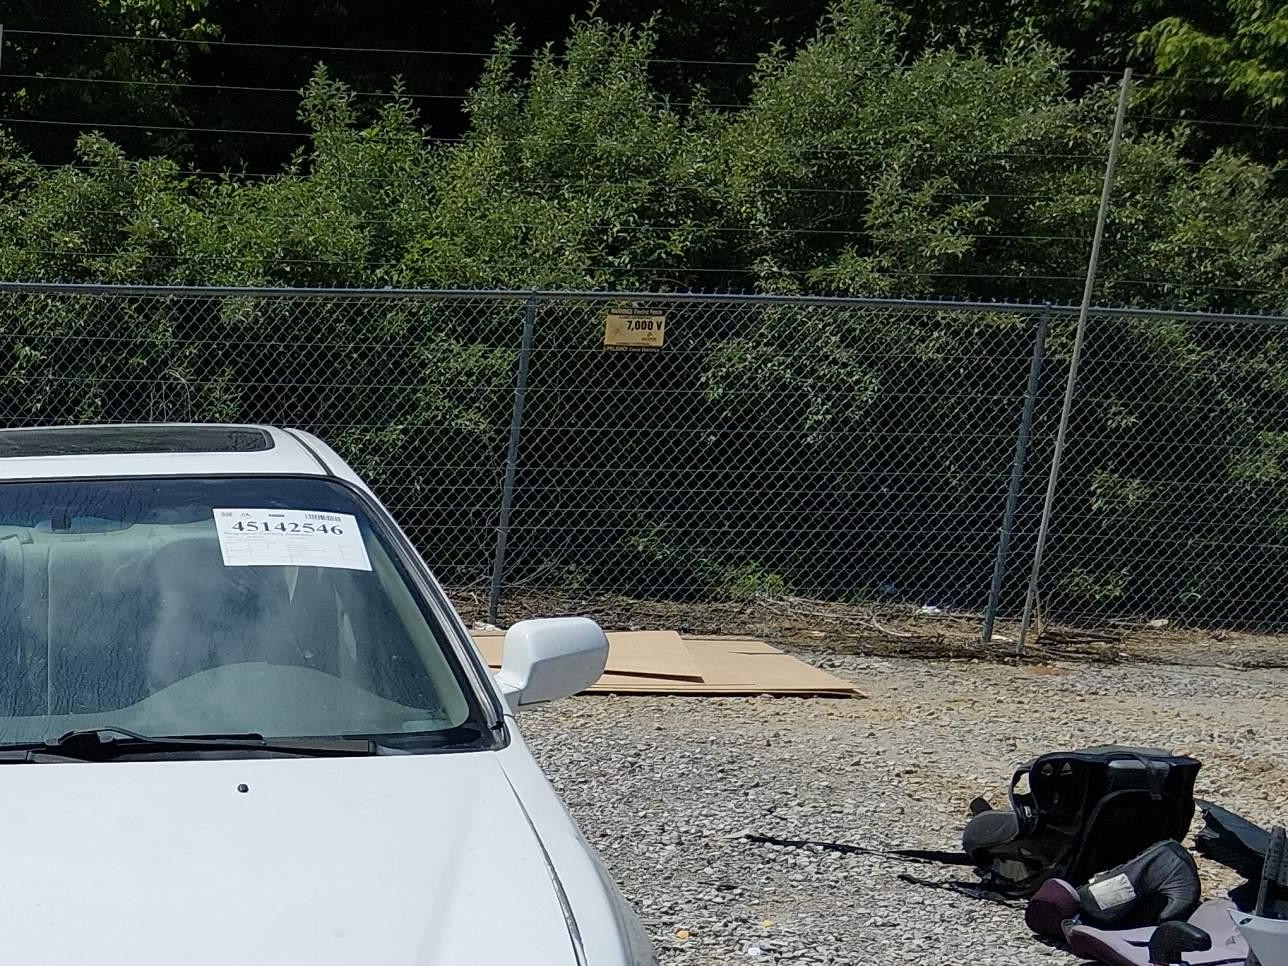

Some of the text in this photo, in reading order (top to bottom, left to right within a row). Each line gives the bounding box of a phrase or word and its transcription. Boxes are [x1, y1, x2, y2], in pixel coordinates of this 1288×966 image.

[627, 320, 663, 331] 7,000 V
[232, 521, 344, 535] 45142546
